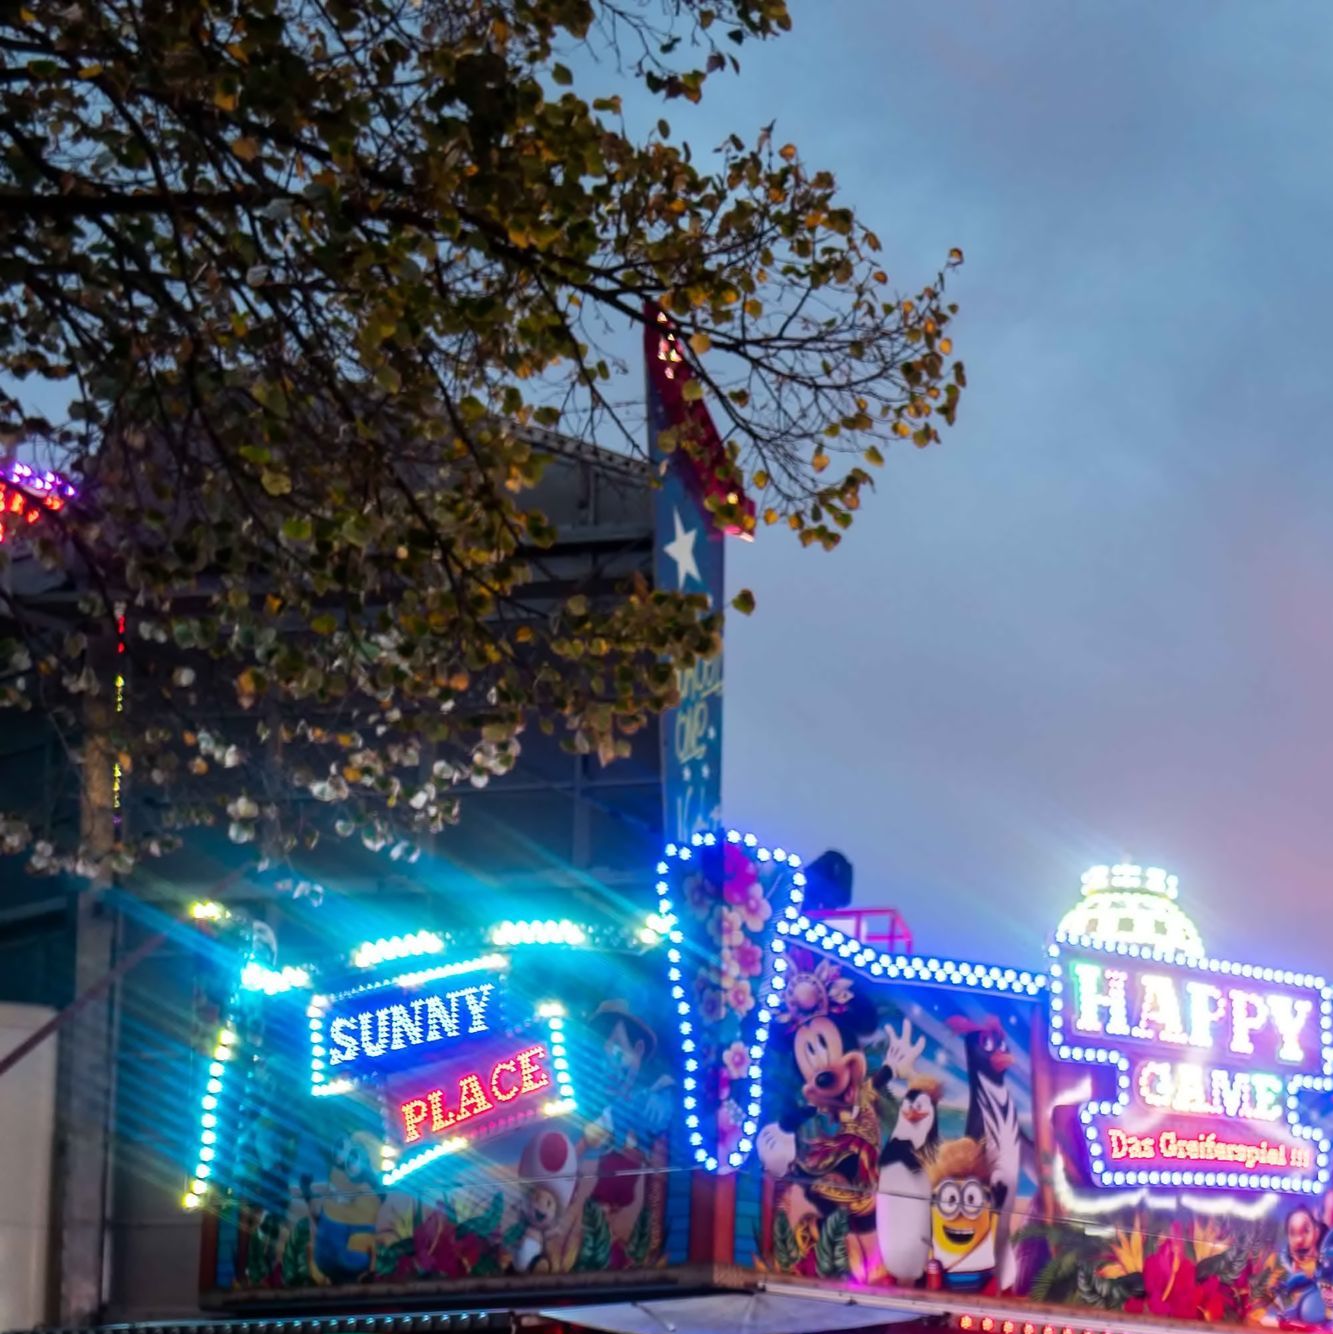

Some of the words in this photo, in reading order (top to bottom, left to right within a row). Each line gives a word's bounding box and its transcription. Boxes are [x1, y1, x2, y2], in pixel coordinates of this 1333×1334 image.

[328, 983, 496, 1066] SUNNY
[1071, 963, 1313, 1062] HAPPY
[400, 1045, 550, 1144] PLACE
[1139, 1061, 1283, 1121] GAME
[1108, 1128, 1156, 1160] Das
[1158, 1131, 1288, 1169] Greiferspiel
